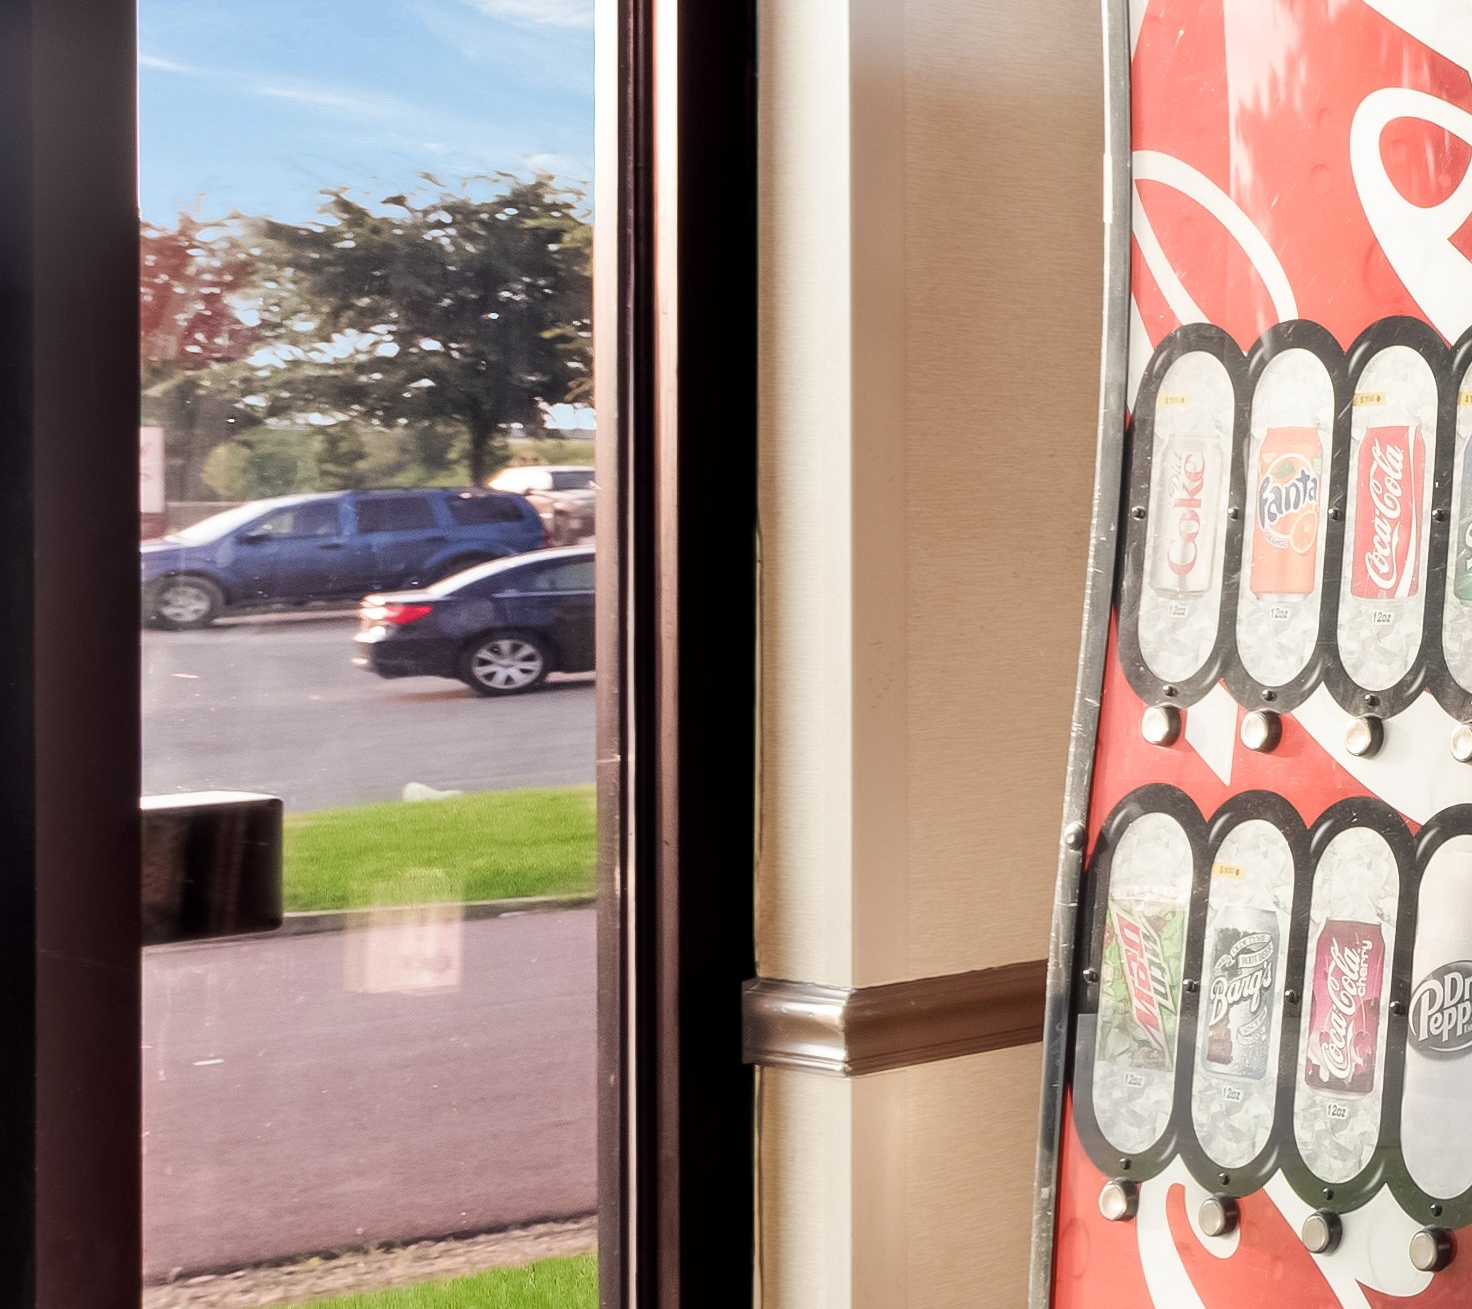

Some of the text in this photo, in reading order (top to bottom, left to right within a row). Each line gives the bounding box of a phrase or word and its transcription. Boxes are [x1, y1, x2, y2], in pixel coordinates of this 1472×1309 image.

[1168, 452, 1206, 577] Coke
[1365, 438, 1405, 589] Coca-Cola
[1372, 611, 1391, 623] 12oz
[1209, 961, 1273, 1026] Barq's
[1357, 939, 1373, 997] cherry
[1319, 937, 1362, 1080] Coca-Cola
[1221, 1087, 1241, 1101] 12oz
[1326, 1104, 1347, 1119] 12oz
